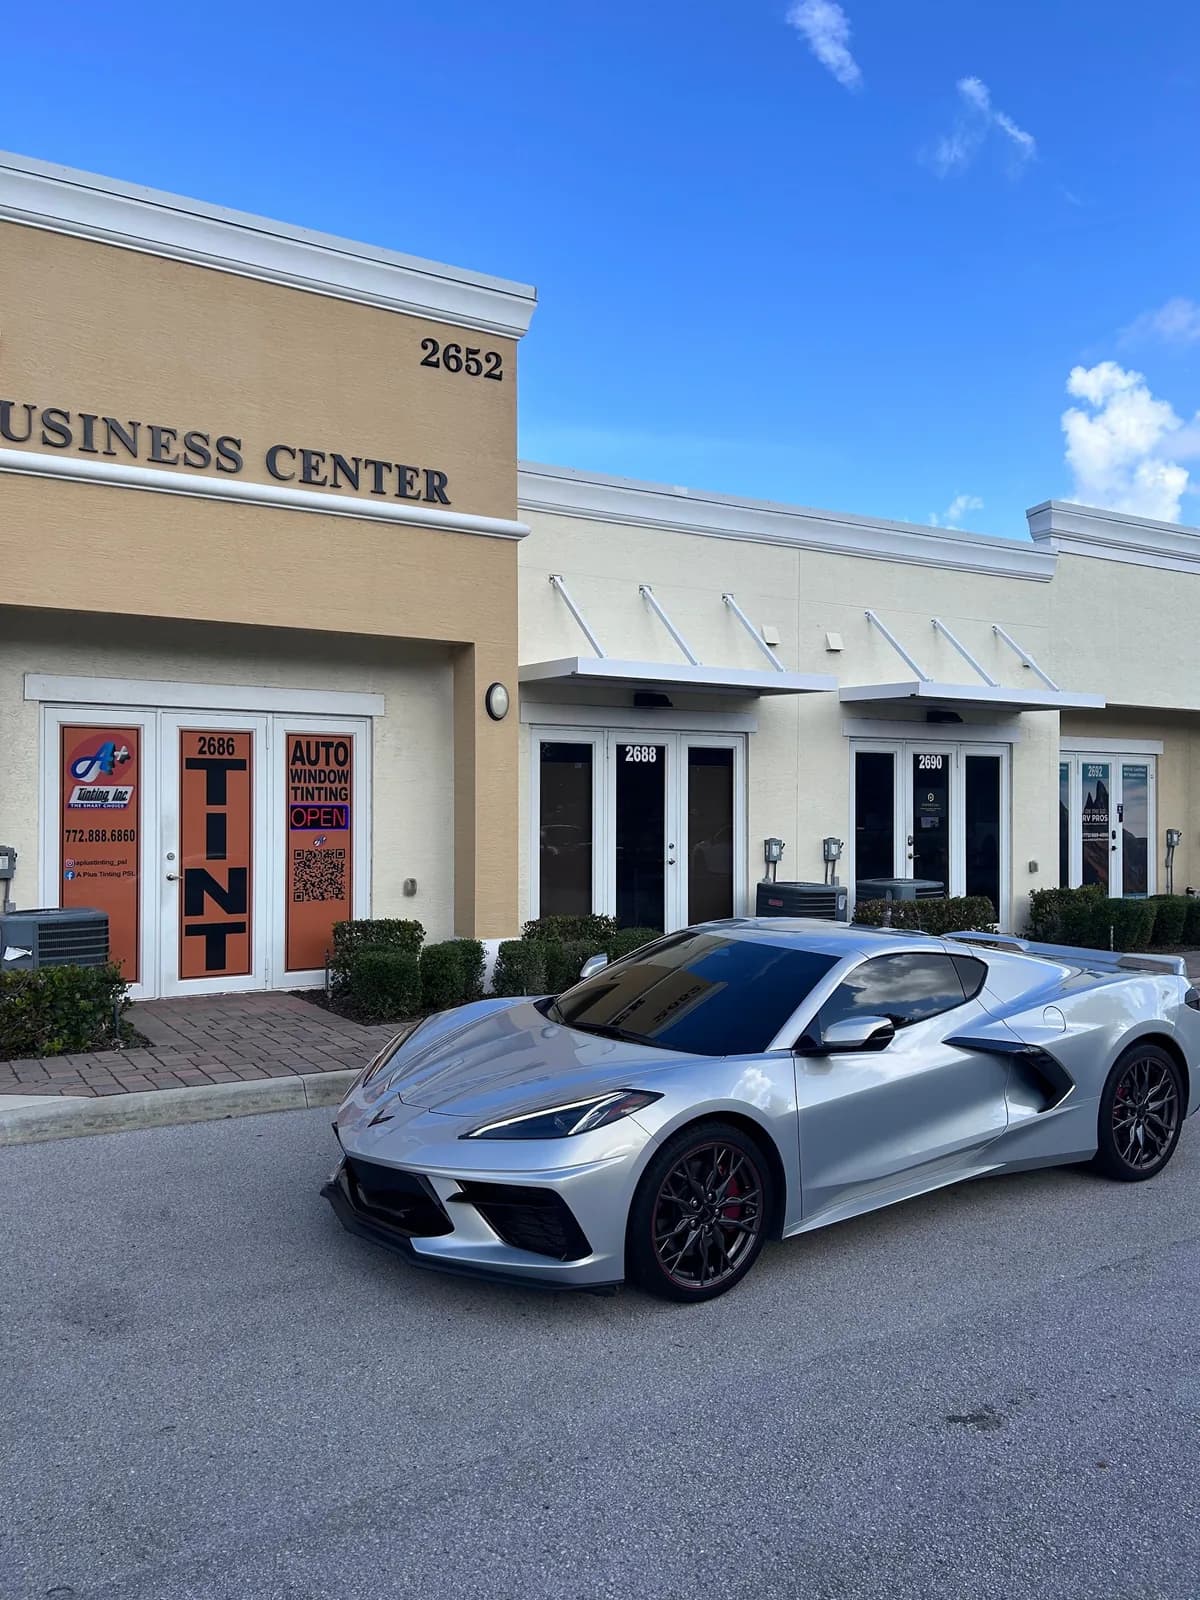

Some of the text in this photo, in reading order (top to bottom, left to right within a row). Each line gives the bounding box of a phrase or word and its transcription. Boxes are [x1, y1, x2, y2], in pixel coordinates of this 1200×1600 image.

[420, 338, 503, 381] 2652
[266, 444, 451, 505] CENTER
[198, 736, 235, 756] 2686
[290, 740, 349, 767] AUTO
[625, 745, 657, 762] 2688
[919, 755, 943, 769] 2690
[290, 768, 349, 785] WINDOW
[1087, 765, 1103, 777] 2692
[291, 786, 349, 802] TINTING
[291, 807, 346, 828] OPEN
[1082, 814, 1108, 822] RV PROS
[65, 829, 135, 842] 772.888.6860
[184, 758, 247, 971] TINT
